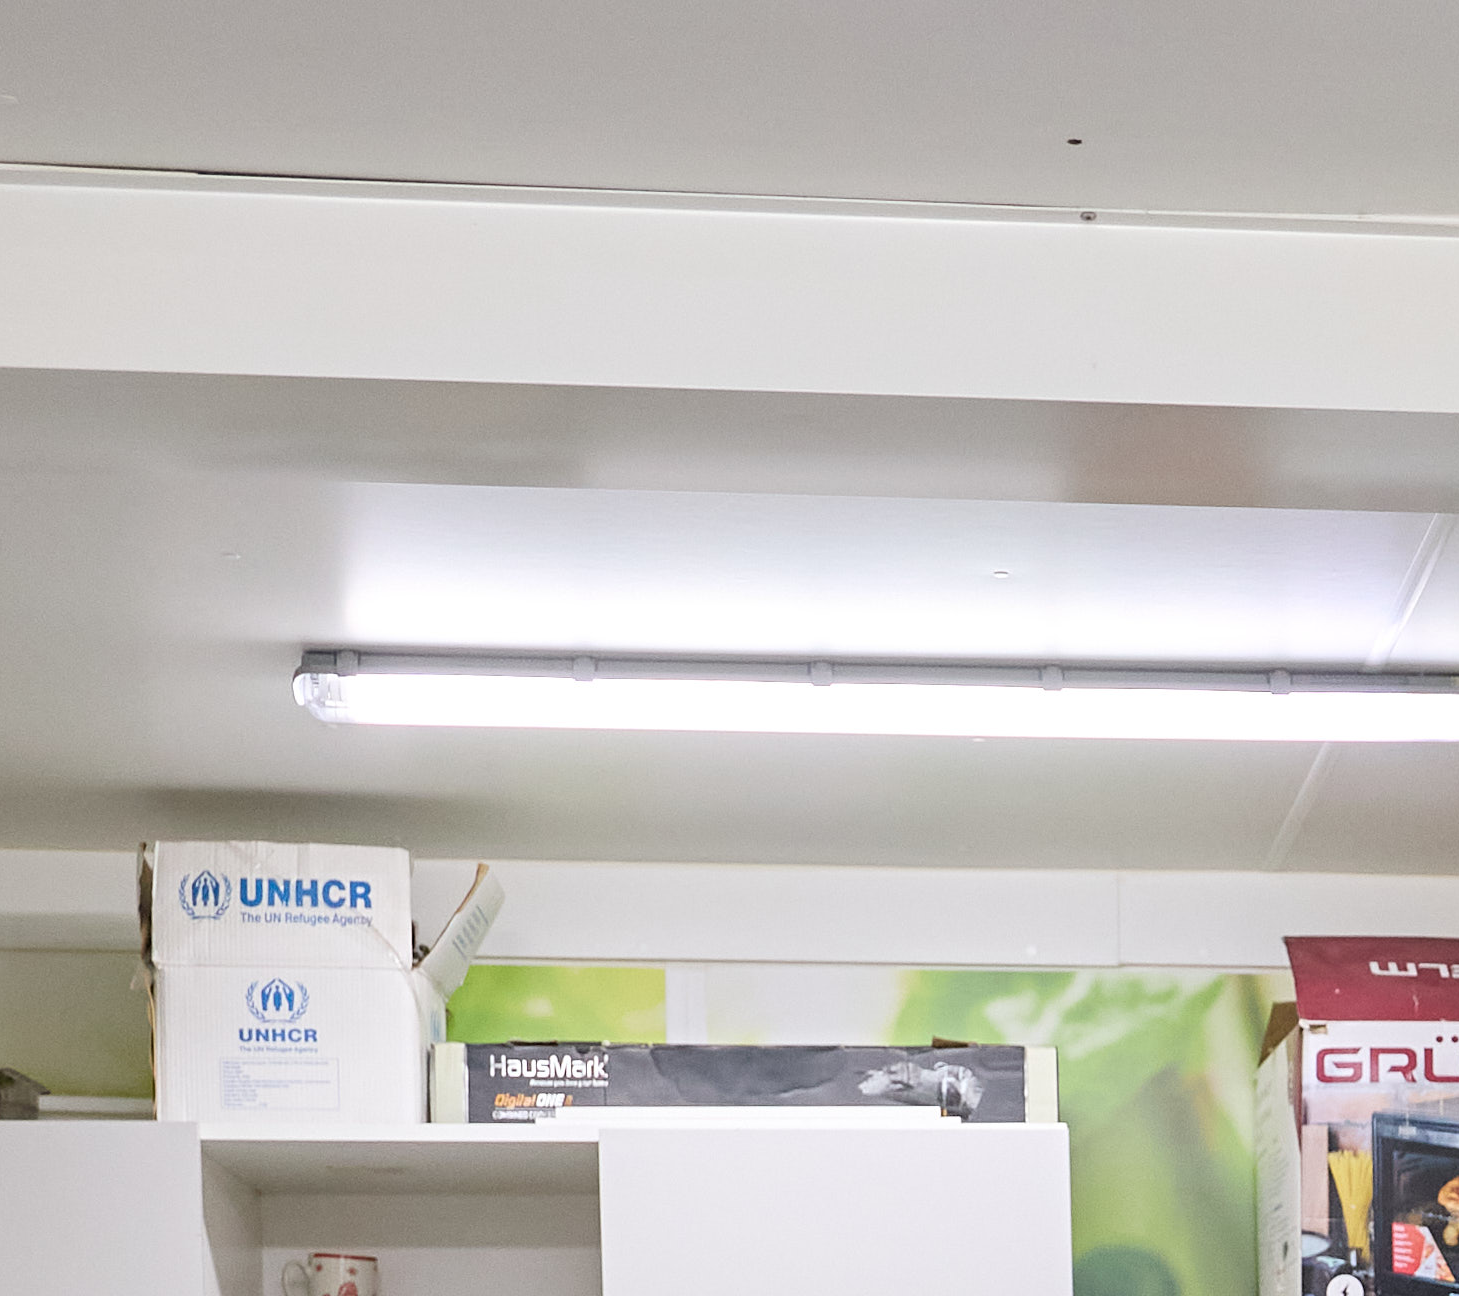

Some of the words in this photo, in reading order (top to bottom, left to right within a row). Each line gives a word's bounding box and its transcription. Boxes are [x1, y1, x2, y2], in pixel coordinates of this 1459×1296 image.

[240, 877, 372, 909] UNHCR
[241, 912, 261, 923] The
[264, 913, 281, 923] UN
[285, 912, 330, 926] Refugee
[239, 1028, 318, 1043] UNHCR
[489, 1054, 609, 1079] HausMark
